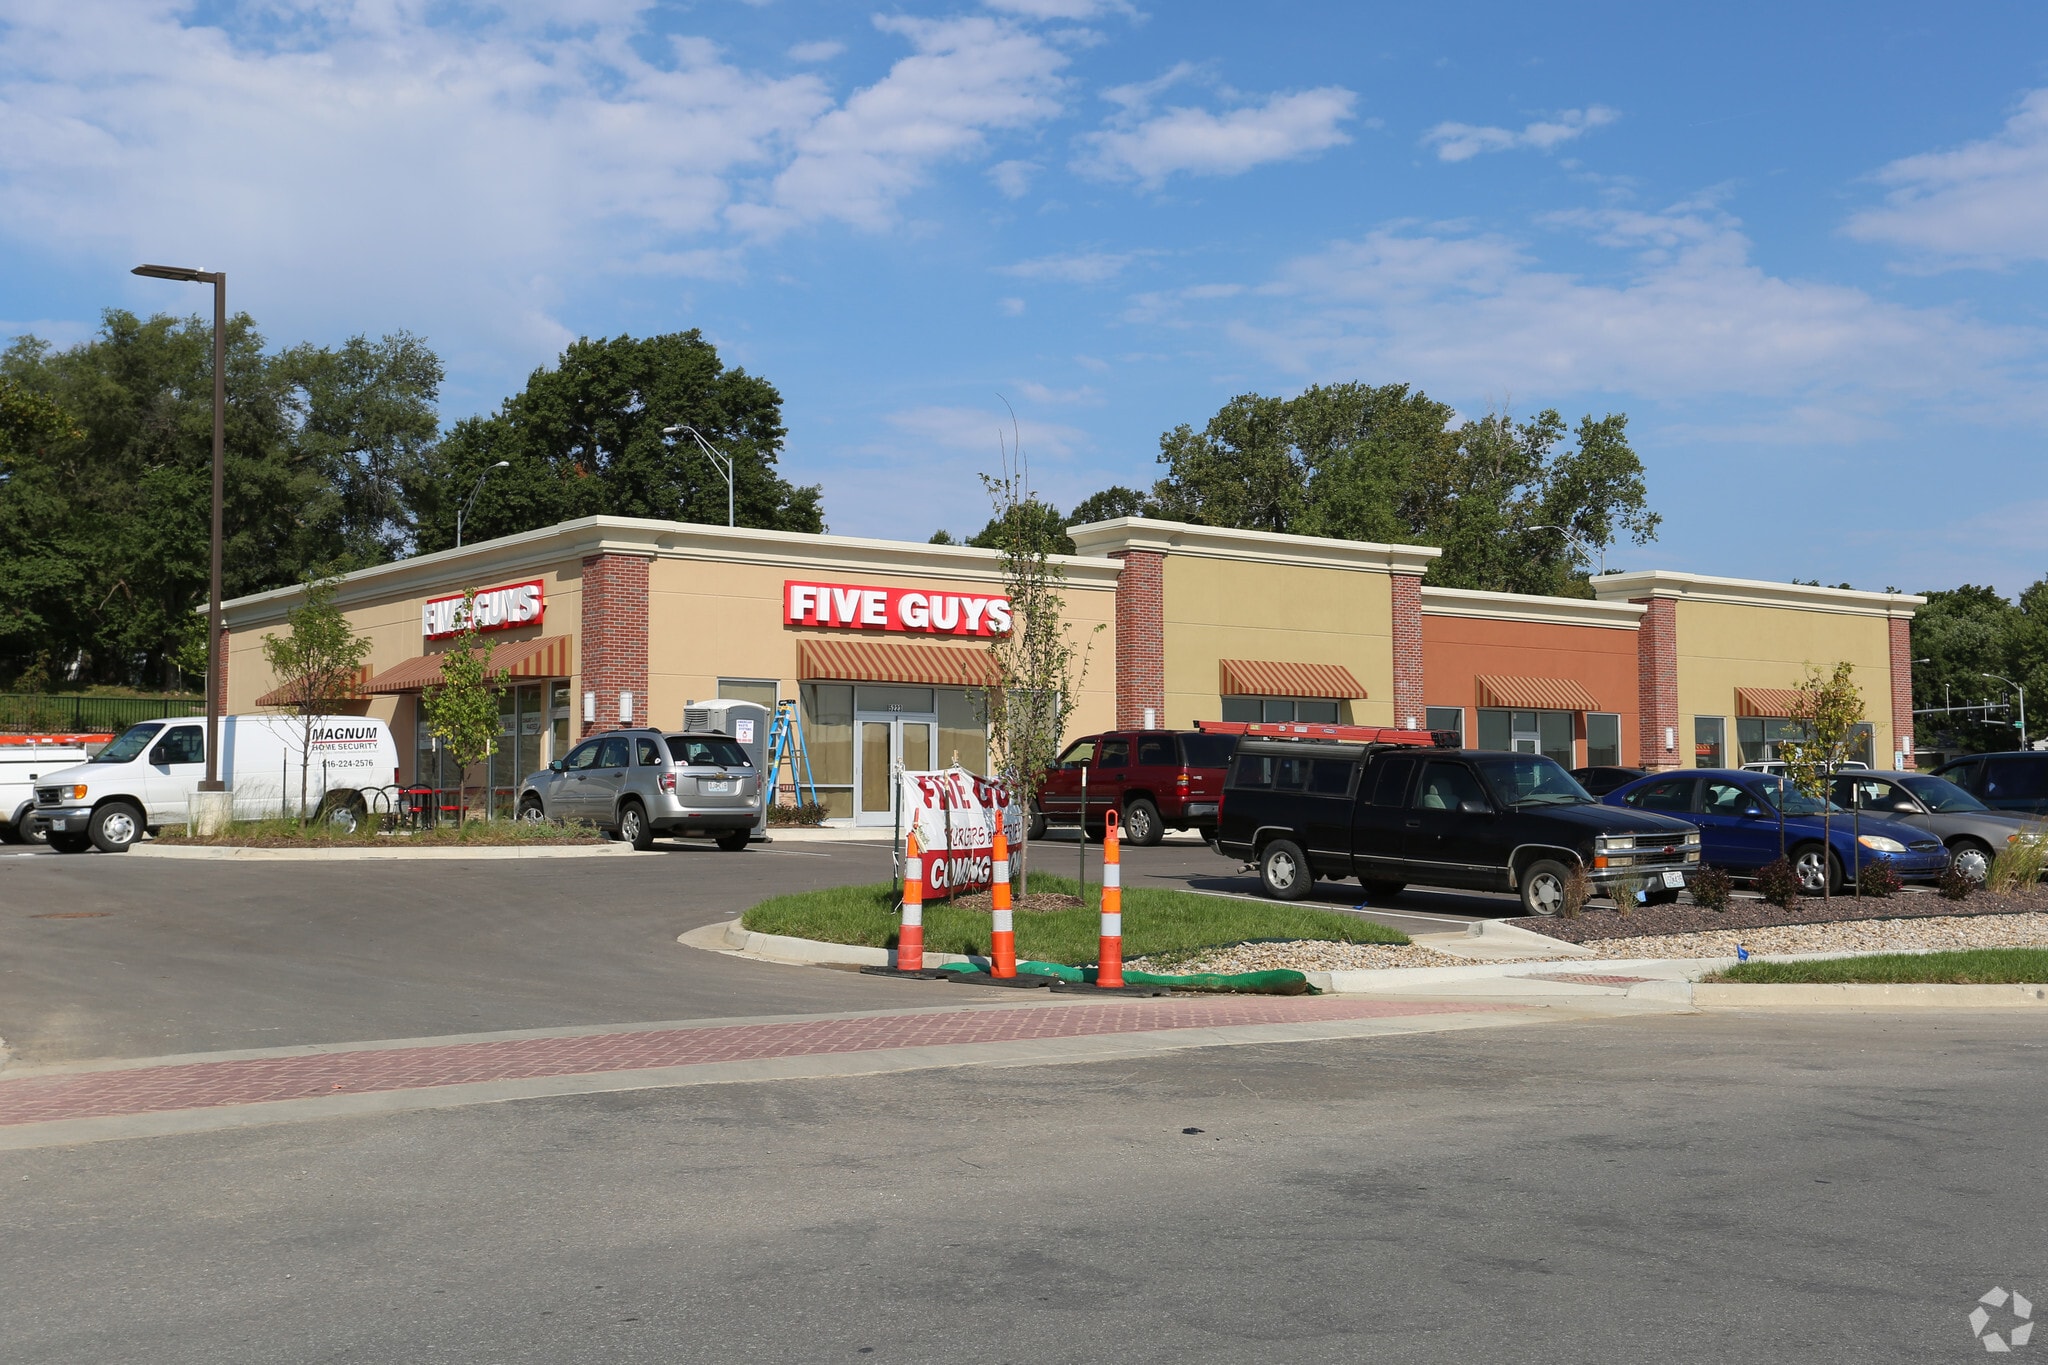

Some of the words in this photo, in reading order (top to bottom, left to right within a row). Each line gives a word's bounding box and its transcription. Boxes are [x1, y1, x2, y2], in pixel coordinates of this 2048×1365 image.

[472, 585, 540, 627] GUYS
[790, 585, 888, 625] FIVE
[898, 592, 1013, 632] GUYS
[312, 728, 377, 740] MAGNUM
[312, 743, 336, 751] HOME
[914, 773, 971, 810] FIVE
[972, 775, 1018, 809] GU
[930, 855, 991, 889] COMING
